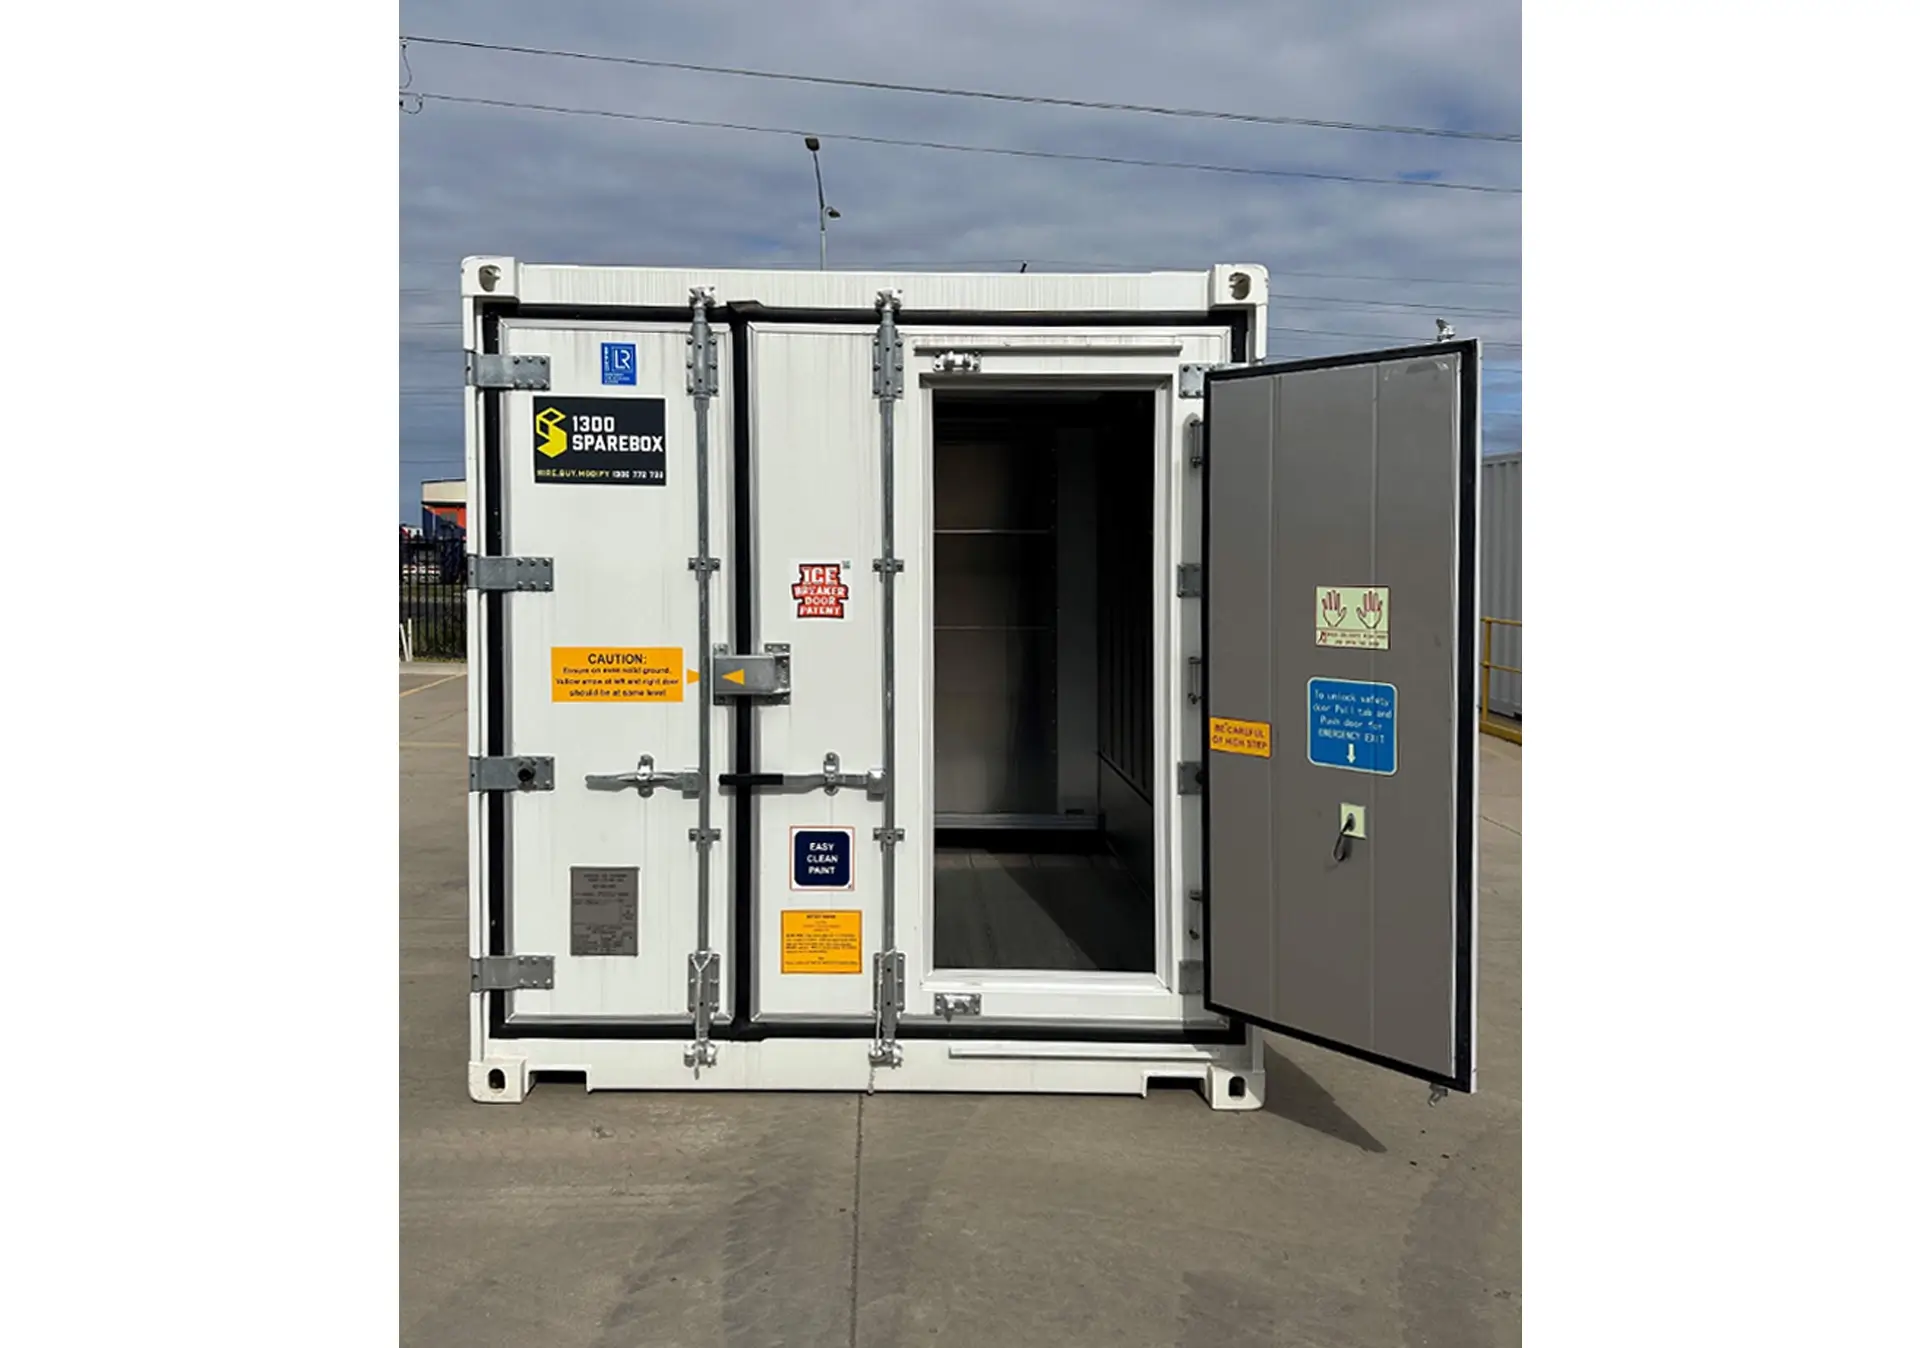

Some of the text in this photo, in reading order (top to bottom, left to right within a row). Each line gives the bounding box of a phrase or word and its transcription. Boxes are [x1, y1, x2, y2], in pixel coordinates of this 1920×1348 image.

[614, 349, 632, 370] LR
[572, 416, 615, 432] 1300
[572, 434, 664, 452] SPAREBOX
[801, 566, 838, 585] ICE
[804, 596, 836, 606] DOOR
[587, 653, 647, 665] CAUTION:
[1314, 689, 1325, 700] To
[809, 842, 835, 852] EASY
[806, 854, 839, 863] CLEAN
[808, 866, 836, 875] PAINT
